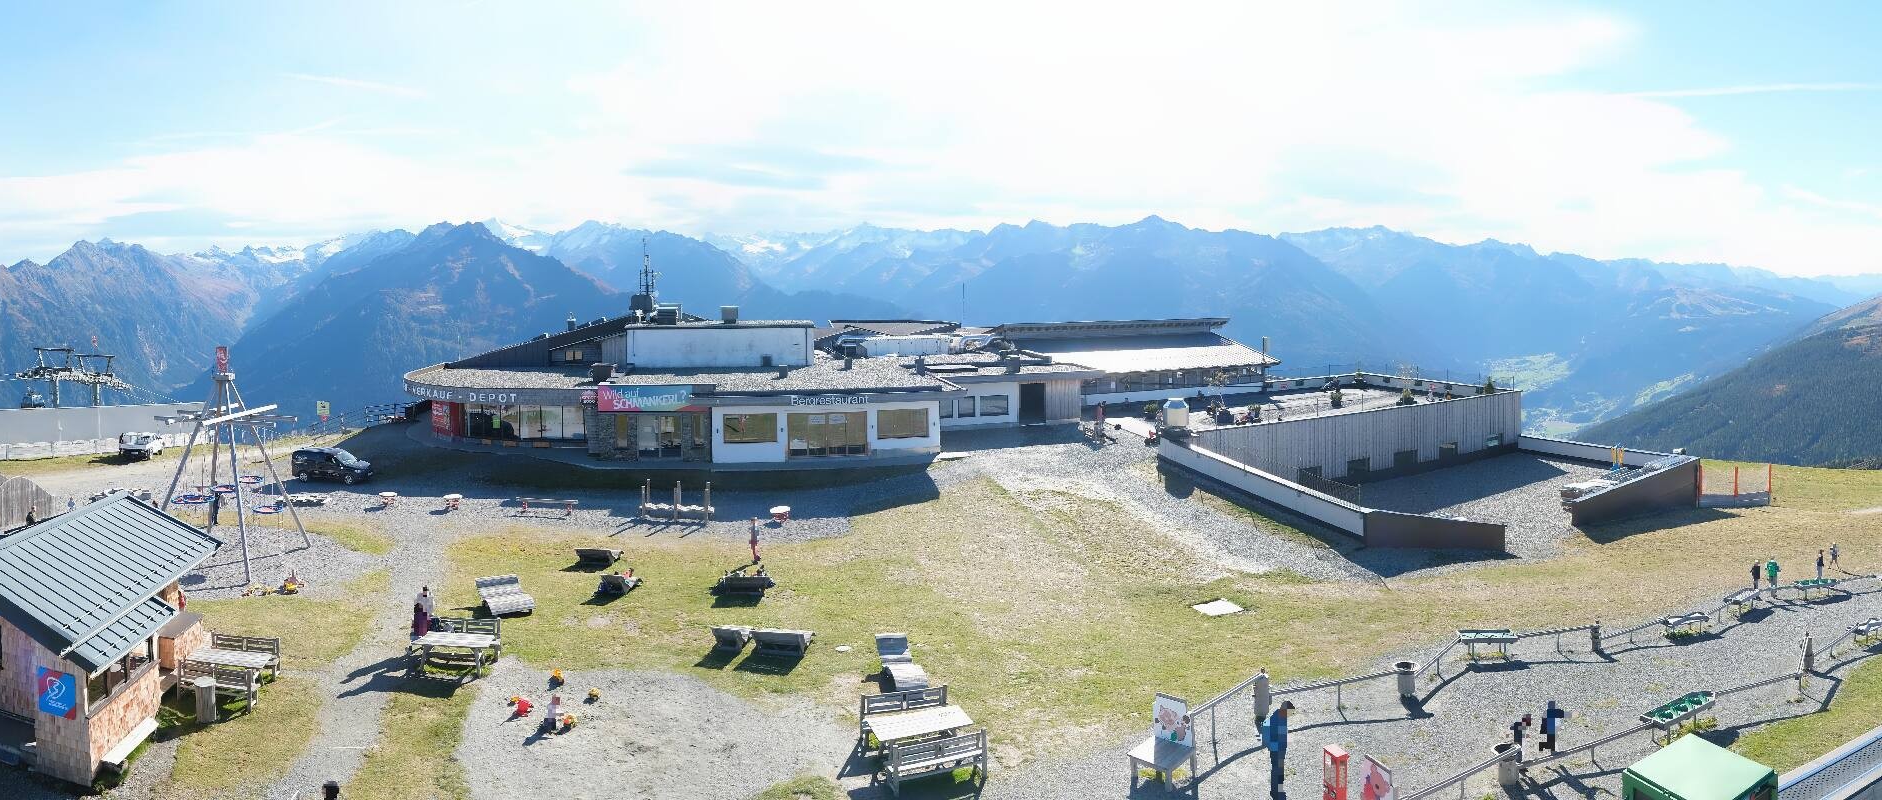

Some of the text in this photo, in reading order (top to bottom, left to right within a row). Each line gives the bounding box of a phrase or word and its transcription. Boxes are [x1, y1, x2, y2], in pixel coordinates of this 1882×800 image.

[412, 387, 453, 400] VERKAUF
[469, 392, 517, 403] DEPOT
[602, 388, 624, 400] Wild
[625, 387, 640, 398] auf
[790, 395, 869, 406] Bergrestaurant
